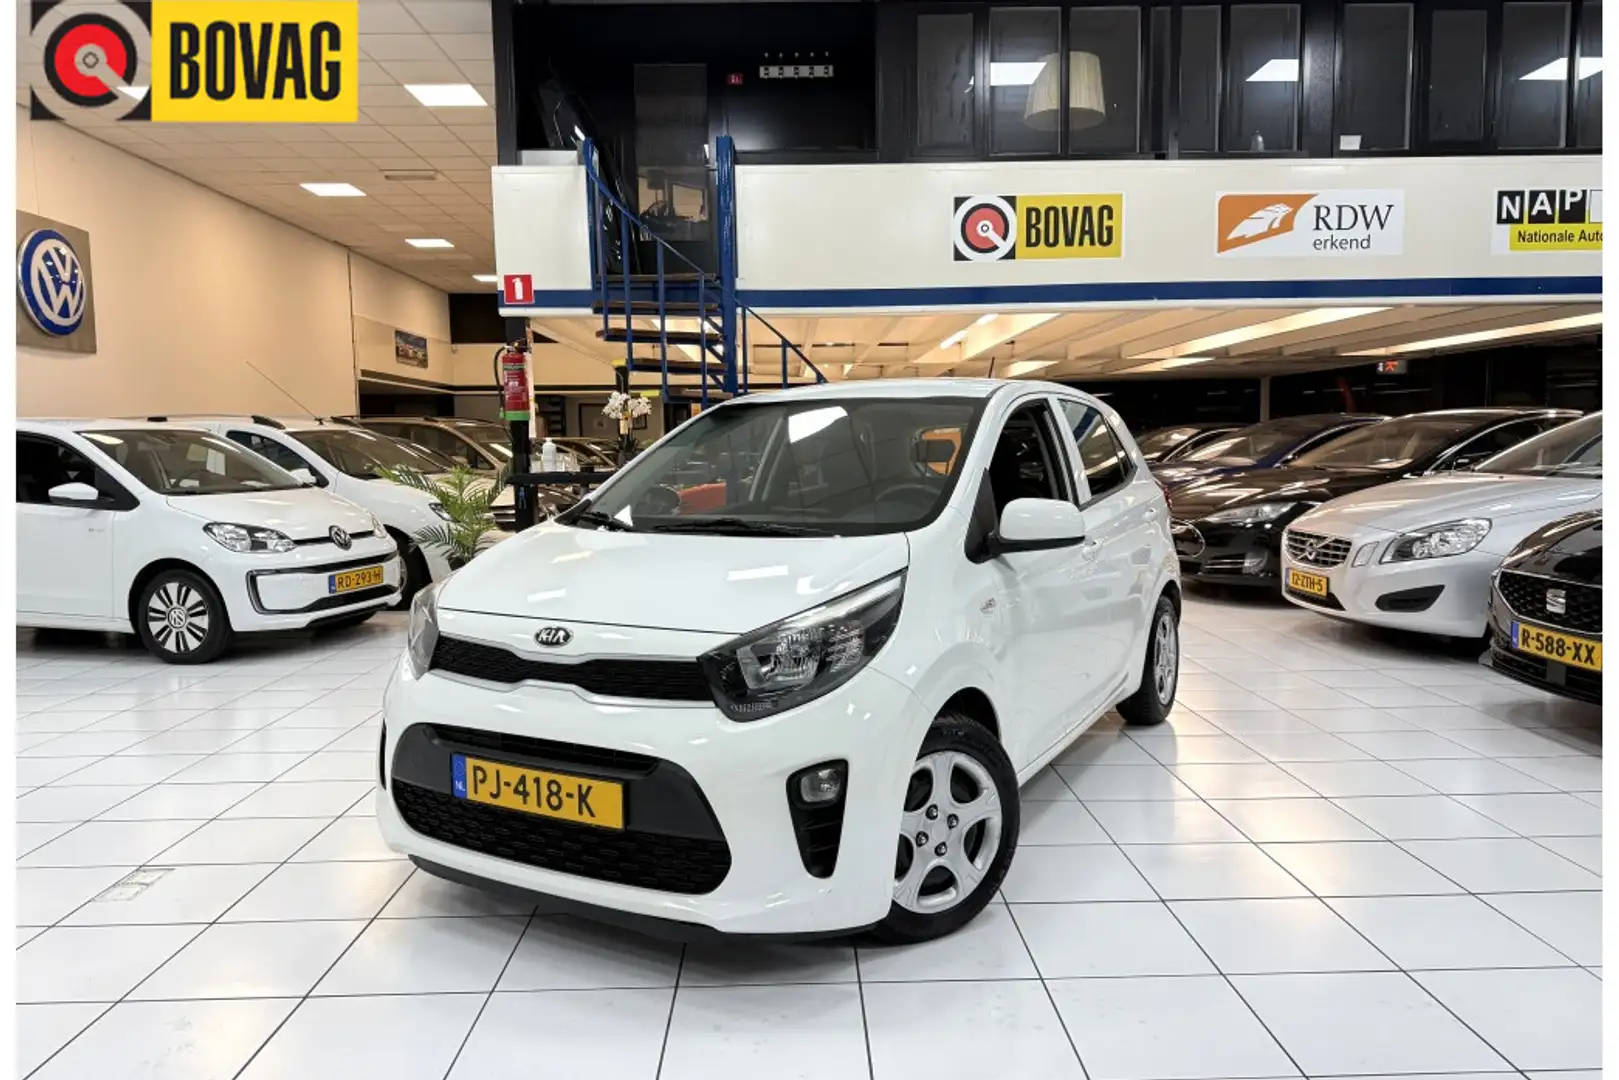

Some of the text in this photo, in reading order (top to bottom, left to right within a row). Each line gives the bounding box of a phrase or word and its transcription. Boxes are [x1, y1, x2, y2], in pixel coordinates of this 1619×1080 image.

[1501, 188, 1583, 219] NAP
[1025, 204, 1113, 247] BOVAG
[1313, 204, 1395, 231] RDW
[1313, 234, 1371, 250] erkend
[1517, 230, 1574, 243] Nationale
[1292, 571, 1323, 592] 12-ZTH-5
[538, 630, 566, 642] KIA
[1521, 628, 1596, 666] R-588-XX
[455, 780, 466, 791] NL
[473, 765, 596, 818] PJ-418-K
